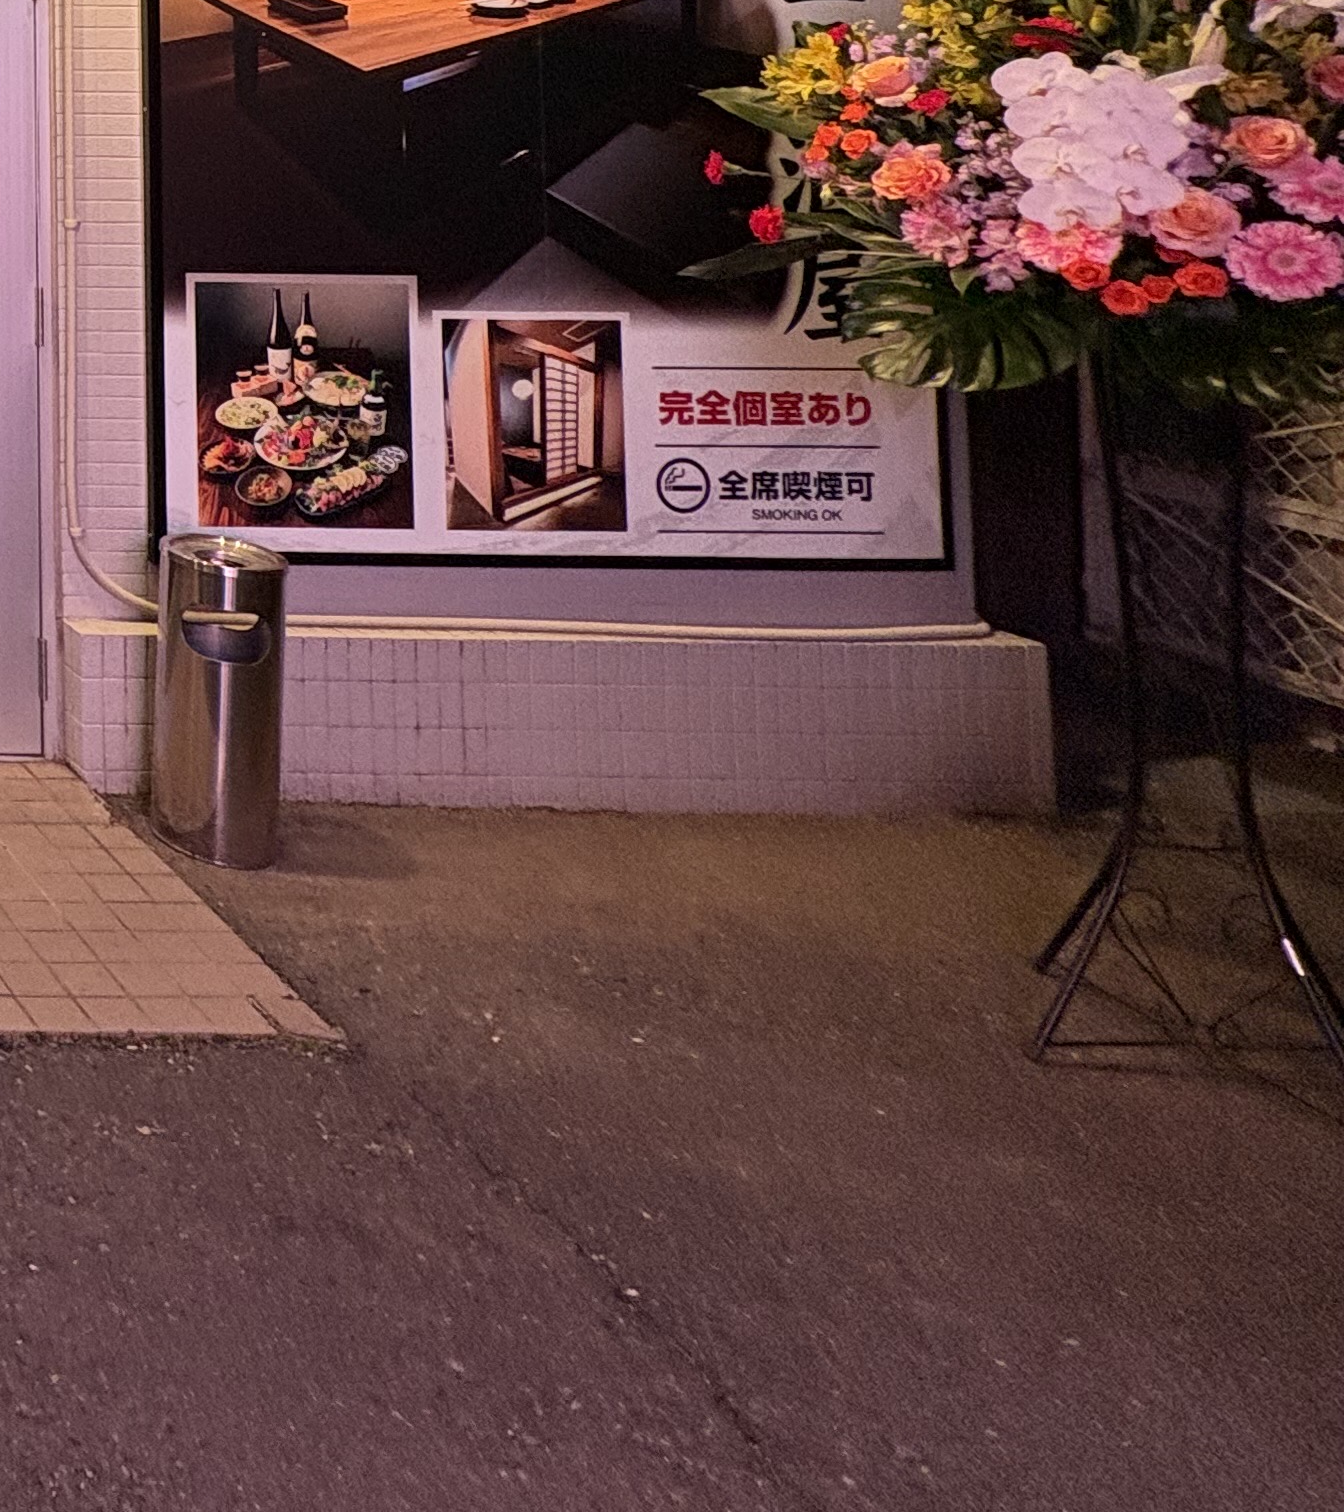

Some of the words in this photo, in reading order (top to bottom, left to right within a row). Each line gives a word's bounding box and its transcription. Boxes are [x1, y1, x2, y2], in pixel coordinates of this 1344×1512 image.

[658, 389, 872, 427] 完全個室あり
[718, 470, 875, 502] 全席喫煙可
[752, 508, 818, 522] SMOKING
[821, 509, 843, 522] OK
